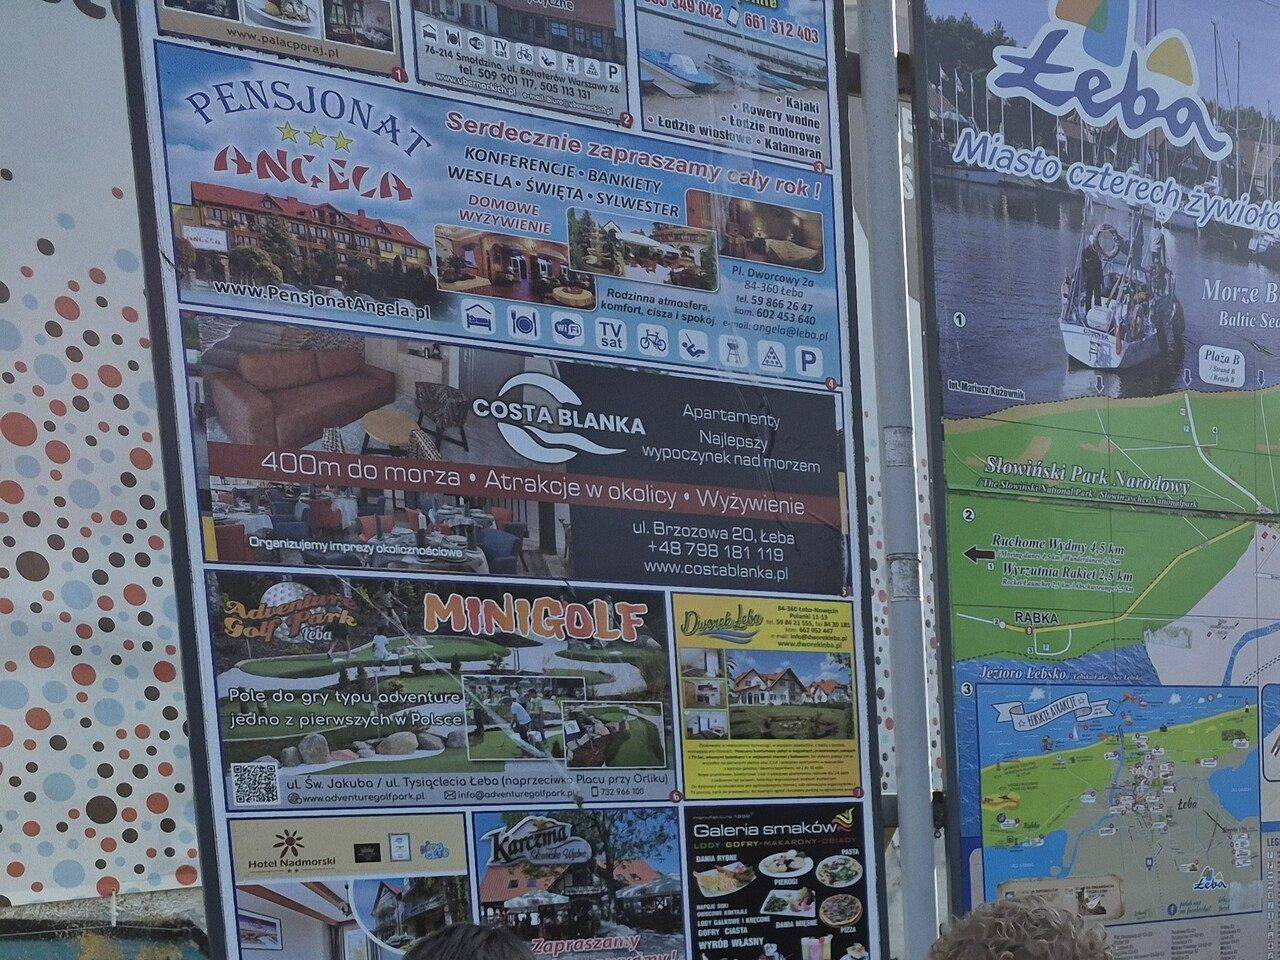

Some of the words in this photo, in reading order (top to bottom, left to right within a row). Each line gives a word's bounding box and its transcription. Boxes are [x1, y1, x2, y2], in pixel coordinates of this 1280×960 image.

[744, 12, 766, 30] 661
[771, 18, 794, 37] 312
[226, 26, 340, 58] www.palacporaj.pl
[994, 29, 1228, 154] Łeba
[785, 96, 820, 114] Kajaki
[184, 79, 433, 157] PENSJONAT
[658, 115, 696, 135] Łodzie
[764, 138, 822, 161] Katamaran
[446, 110, 582, 154] Serdecznie
[586, 140, 722, 184] zapraszamy
[726, 166, 768, 193] cały
[775, 178, 810, 198] rok
[464, 145, 576, 178] KONFERENCJE
[587, 169, 663, 194] BANKIETY
[954, 128, 1062, 182] Miasto
[1067, 162, 1182, 210] czterech
[448, 165, 513, 190] WESELA
[525, 176, 585, 202] ŚWIĘTA
[596, 191, 680, 218] SYLWESTER
[468, 194, 540, 216] DOMOWE
[459, 209, 552, 234] WYŻYWIENIE
[732, 266, 744, 276] Pl.
[748, 268, 800, 286] Dworcowy
[802, 278, 814, 287] 2a
[214, 279, 432, 321] www.PensjonatAngela.pl
[744, 281, 779, 294] 84-360
[781, 288, 804, 298] Łeba
[1201, 278, 1260, 302] Morze
[735, 306, 754, 316] kom.
[757, 308, 774, 319] 602
[777, 312, 795, 322] 453
[798, 315, 816, 325] 640
[751, 295, 764, 305] 59
[766, 298, 784, 308] 866
[787, 301, 799, 311] 26
[801, 303, 813, 313] 47
[1218, 311, 1256, 328] Baltic
[753, 323, 829, 341] angela@leba.pl
[1204, 349, 1231, 366] Plaża
[1232, 352, 1241, 365] B
[960, 381, 990, 395] Mariusz
[472, 398, 553, 424] COSTA
[558, 411, 646, 436] BLANKA
[682, 403, 781, 431] Apartamenty
[700, 429, 768, 452] Najlepszy
[642, 444, 731, 466] wypoczynek
[734, 453, 761, 468] nad
[763, 457, 822, 474] morzem
[260, 451, 342, 478] 400m
[348, 458, 378, 480] do
[384, 465, 460, 487] morza
[484, 469, 581, 498] Atrakcje
[585, 485, 603, 498] w
[608, 482, 677, 510] okolicy
[696, 488, 806, 516] Wyżywienie
[984, 455, 1066, 481] Słowiński
[1070, 465, 1108, 485] Park
[1113, 470, 1191, 497] Narodowy
[632, 521, 649, 536] ul.
[654, 521, 729, 541] Brzozowa
[732, 527, 757, 544] 20,
[760, 530, 796, 545] Łeba
[992, 534, 1045, 550] Ruchome
[1049, 537, 1088, 554] Wydmy
[1090, 541, 1106, 554] 4,5
[1109, 544, 1126, 555] km
[248, 535, 329, 553] Organizujemy
[329, 541, 375, 556] imprezy
[376, 542, 463, 559] okolicznościowe
[648, 541, 682, 556] +48
[686, 543, 719, 559] 798
[725, 546, 750, 560] 181
[757, 547, 784, 562] 119
[643, 559, 789, 582] www.costablanka.pl
[1002, 563, 1059, 579] Wyrzutnia
[1063, 566, 1096, 581] Rakiet
[1099, 568, 1114, 582] 2,5
[1117, 571, 1134, 582] km
[424, 592, 648, 642] MINIGOLF
[979, 665, 1022, 679] Jezioro
[1027, 667, 1066, 679] Łebsko
[228, 688, 266, 702] Pole
[272, 690, 295, 702] do
[301, 692, 328, 707] gry
[335, 691, 372, 706] typu
[378, 692, 461, 704] adventure
[230, 712, 278, 729] jedno
[285, 716, 294, 726] z
[300, 713, 391, 730] pierwszych
[394, 716, 406, 726] w
[411, 713, 462, 726] Polsce
[286, 780, 301, 790] ul.
[305, 776, 325, 790] Św.
[327, 777, 374, 789] Jakuba
[402, 776, 468, 790] Tysiąclecia
[470, 776, 499, 787] Łeba
[576, 775, 605, 785] Placu
[608, 775, 631, 788] przy
[633, 773, 669, 785] Orliku)
[303, 791, 426, 804] www.adventuregolfpark.pl
[457, 788, 575, 801] info@adventuregolfpark.pl
[616, 787, 630, 795] 966
[632, 787, 644, 795] 100
[693, 823, 759, 837] Galeria
[763, 820, 838, 835] smaków
[489, 828, 569, 864] Karczma
[726, 840, 759, 848] GOFRY
[248, 858, 278, 869] Hotel
[280, 856, 336, 867] Nadmorski
[699, 938, 729, 949] WYRÓB
[731, 937, 764, 947] WŁASNY
